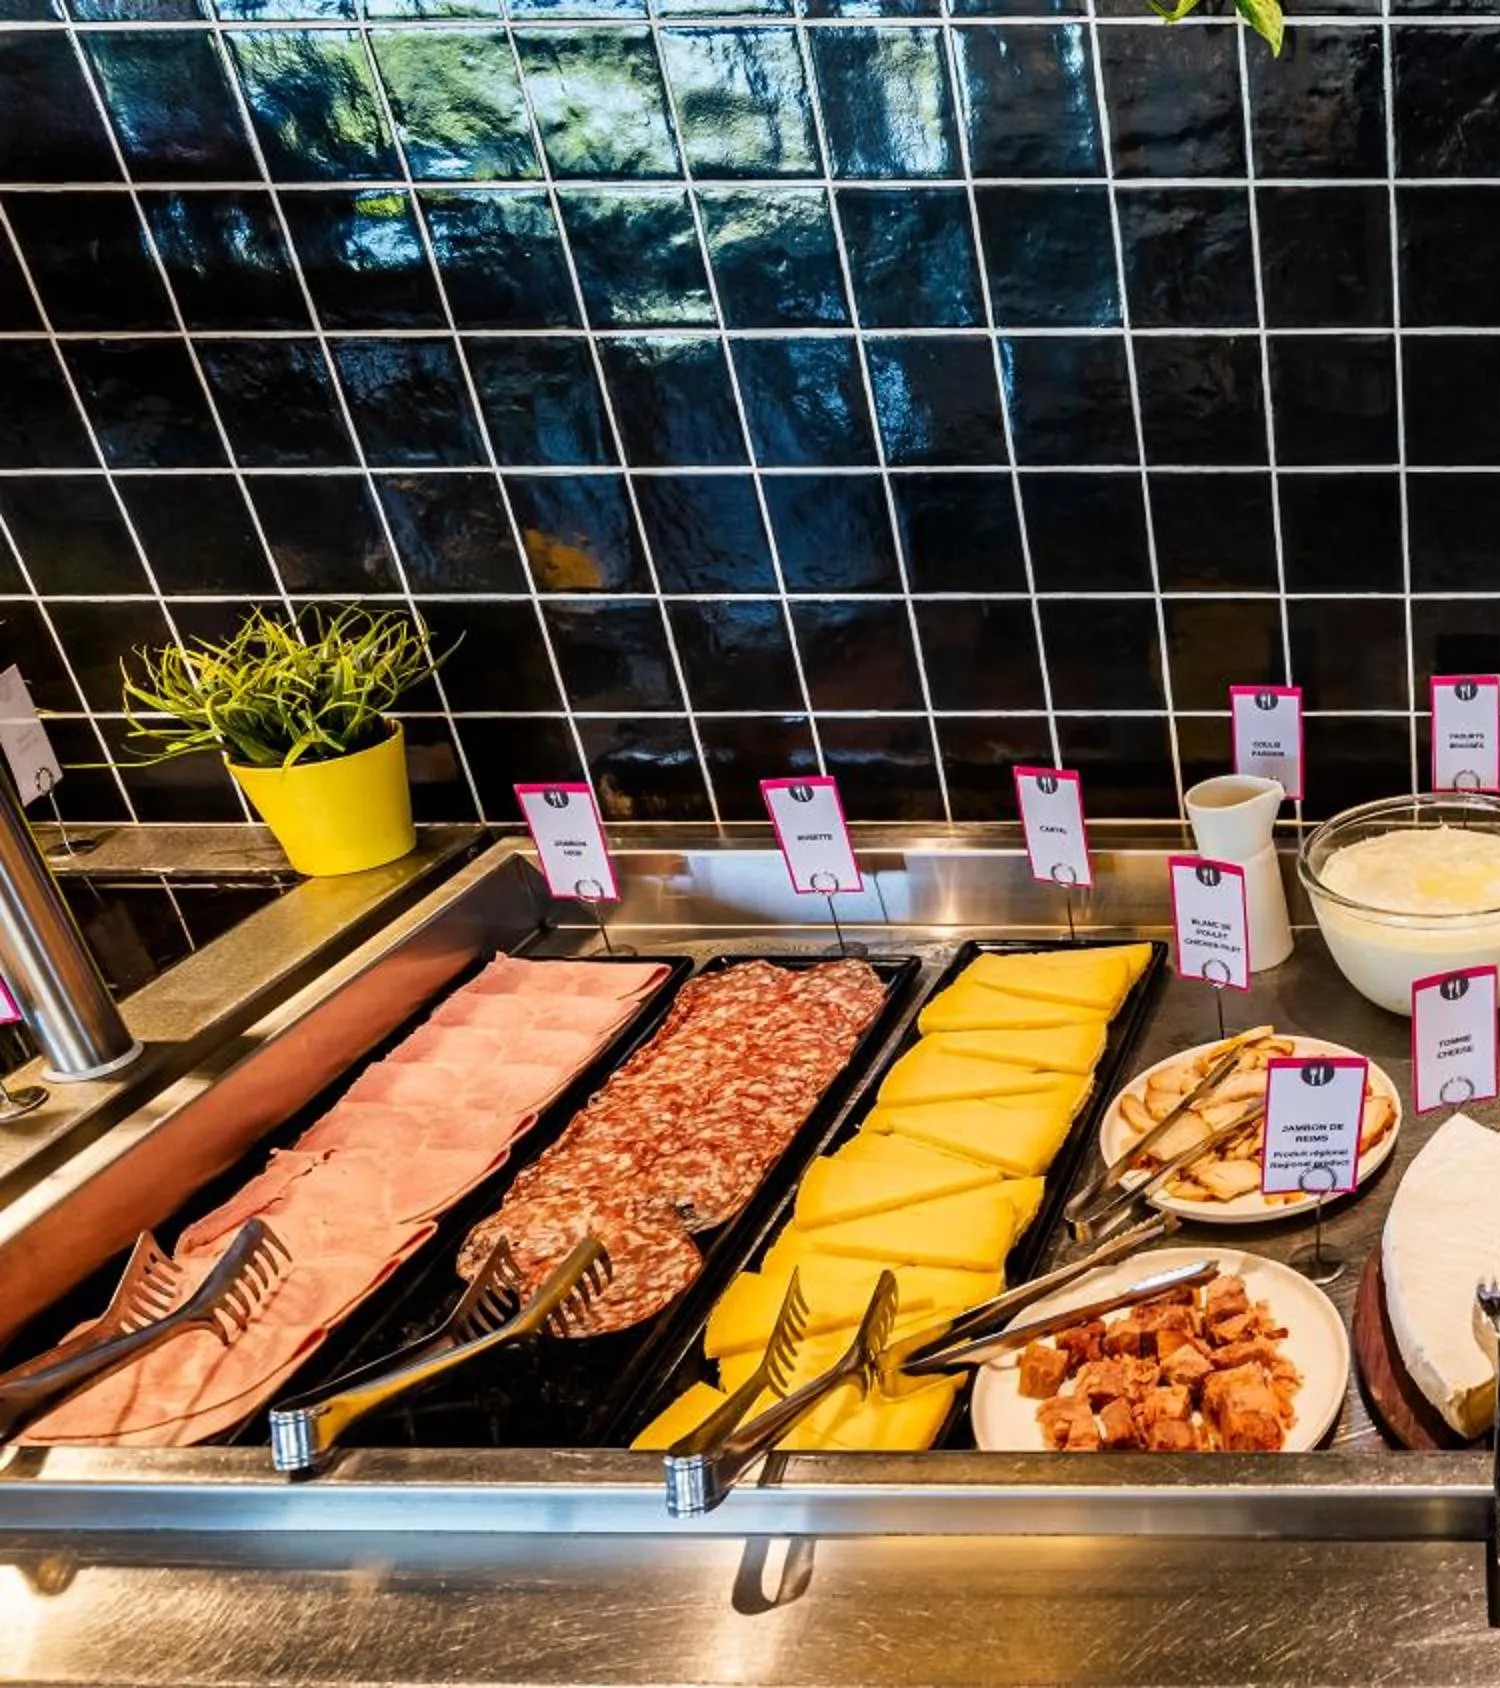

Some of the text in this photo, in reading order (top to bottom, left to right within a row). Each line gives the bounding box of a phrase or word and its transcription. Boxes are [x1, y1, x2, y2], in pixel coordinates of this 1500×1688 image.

[1191, 919, 1219, 928] BLANC
[1196, 928, 1228, 938] POULET
[1437, 1045, 1473, 1059] CHEESE
[1281, 1123, 1328, 1132] JAMBON
[1295, 1135, 1329, 1143] REIMS
[1273, 1150, 1308, 1158] Produit
